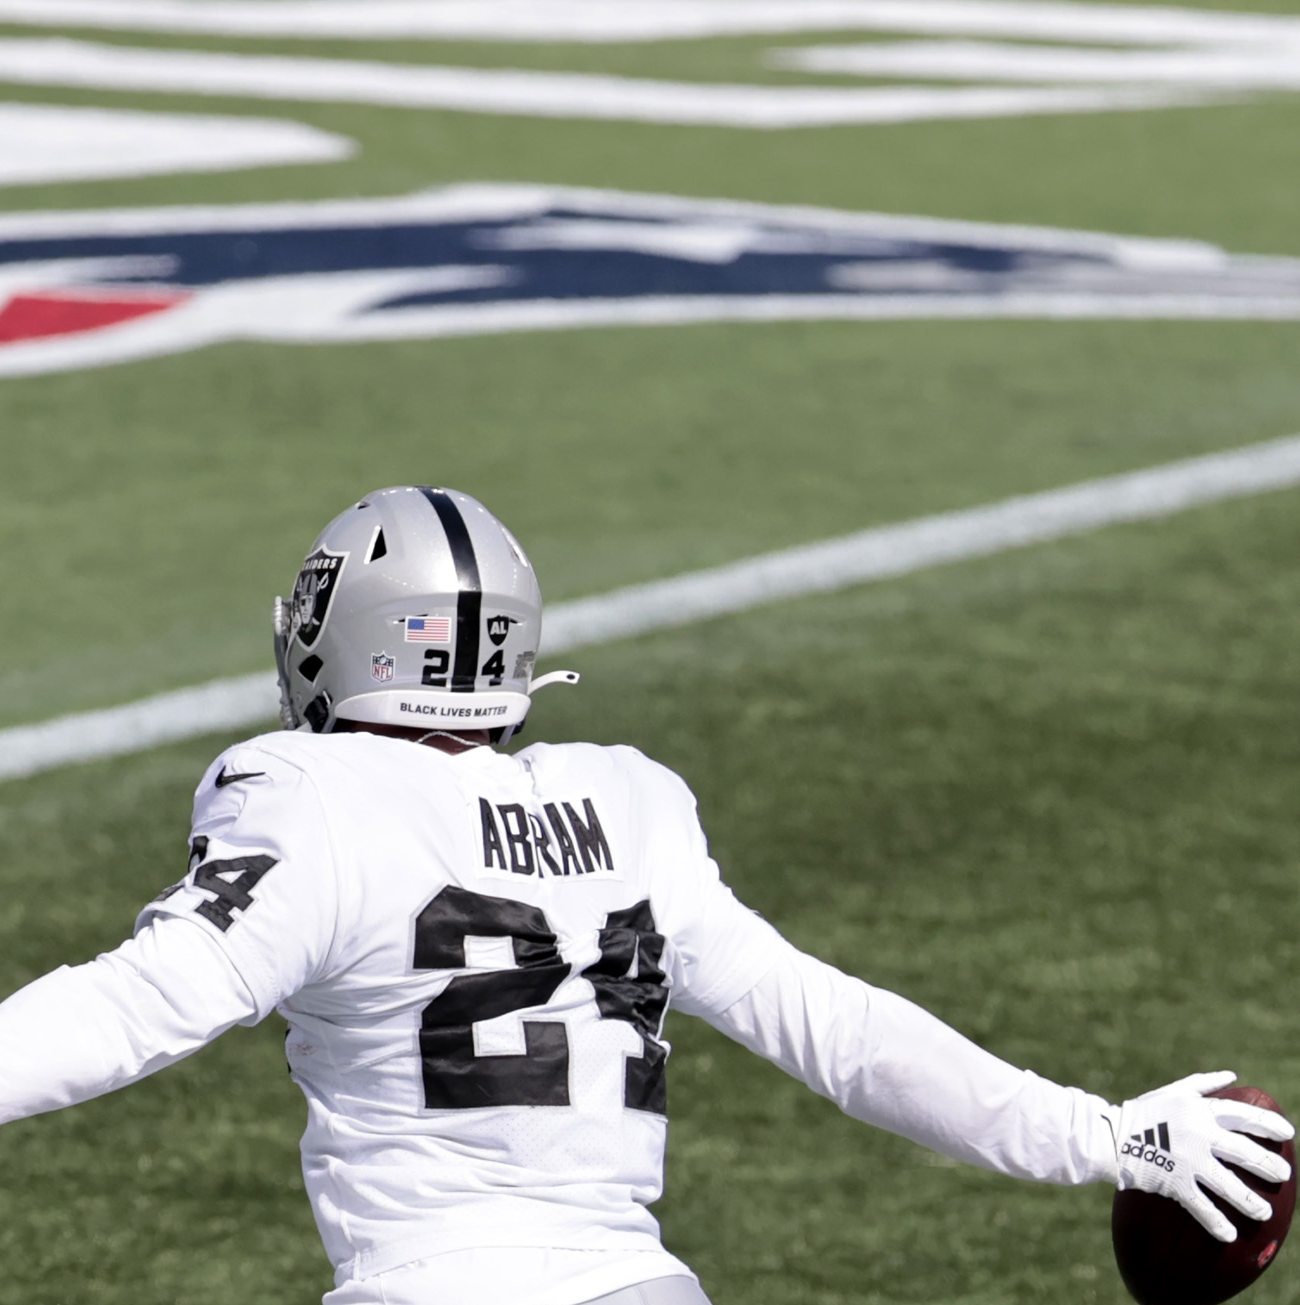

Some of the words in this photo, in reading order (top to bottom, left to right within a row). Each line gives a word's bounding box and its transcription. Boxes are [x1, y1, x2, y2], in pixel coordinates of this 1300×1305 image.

[302, 557, 338, 570] AIDERS
[489, 620, 508, 636] AL
[372, 665, 393, 679] NFL
[399, 702, 437, 716] BLACK
[440, 706, 472, 718] LIVES
[474, 705, 508, 718] MATTER
[478, 796, 615, 879] ABRAM
[411, 884, 672, 1117] 24
